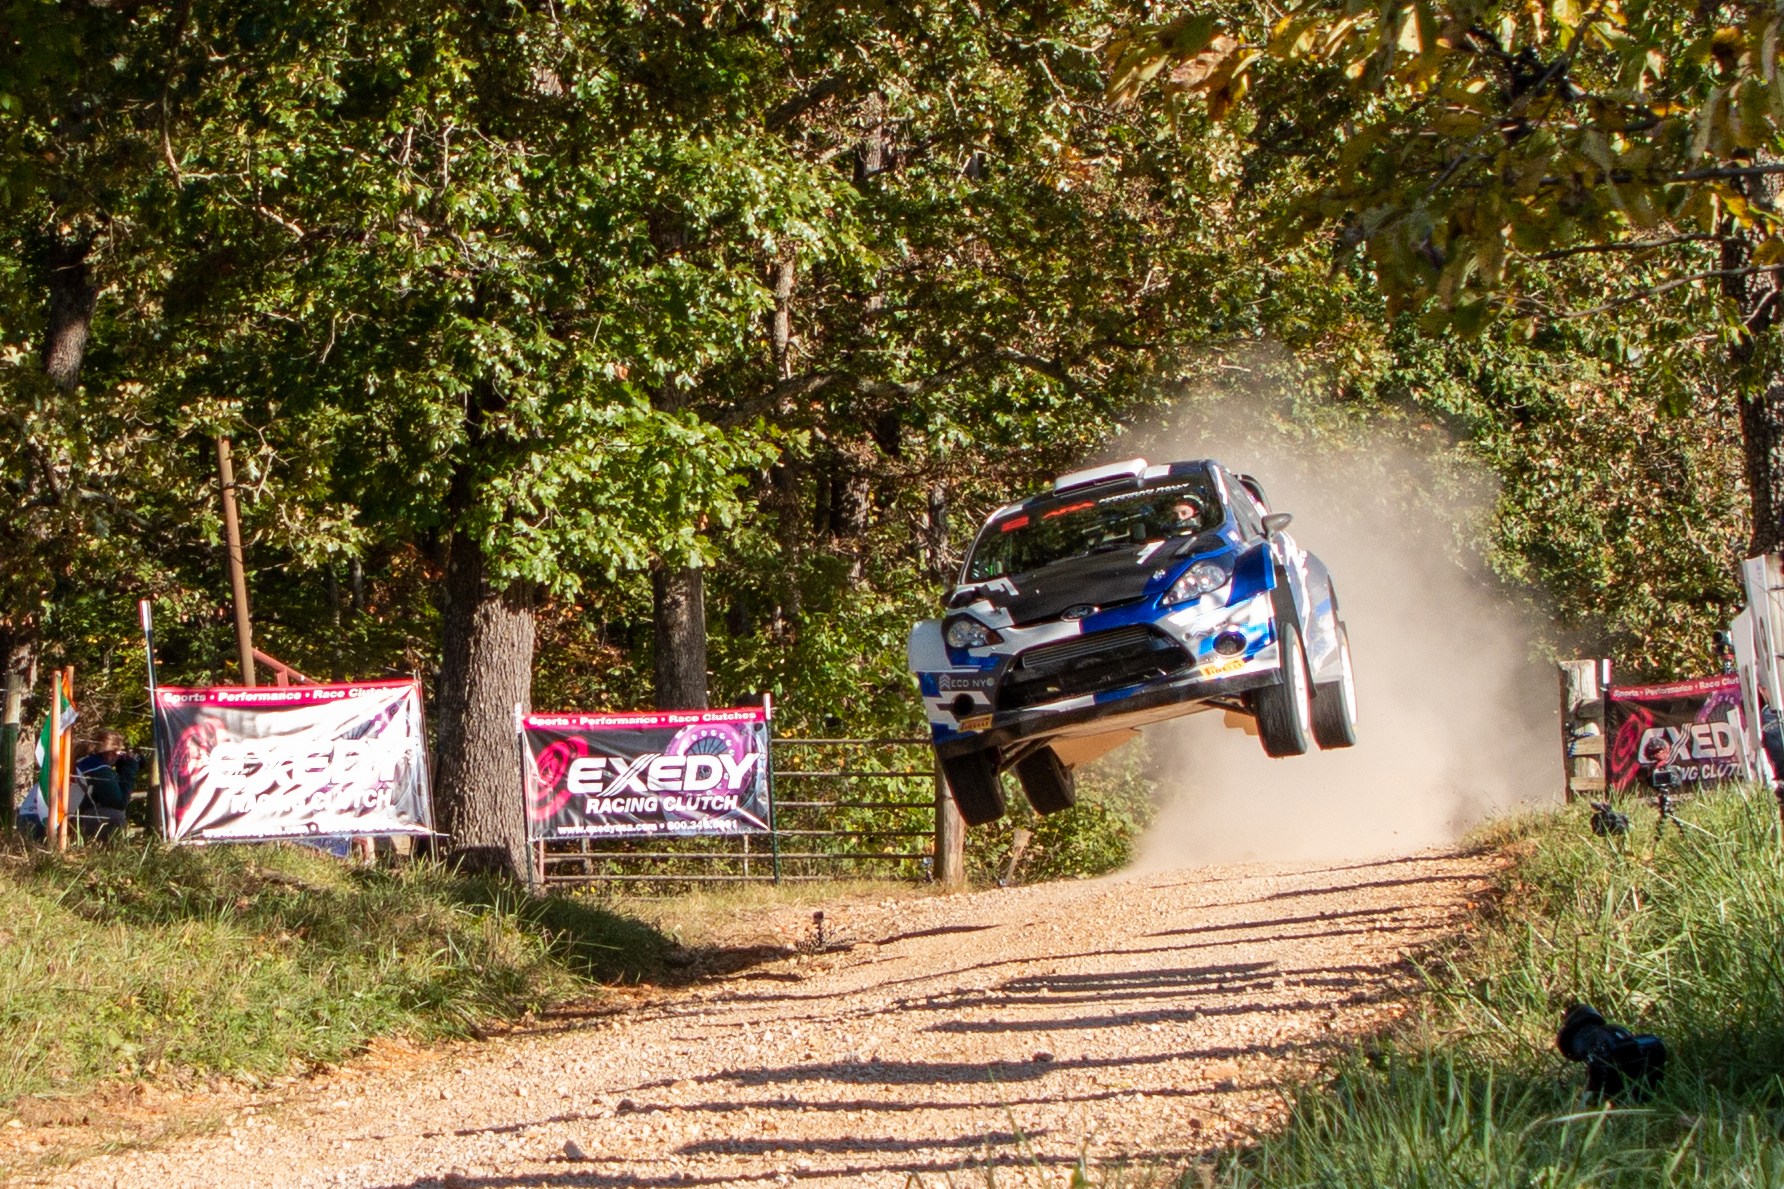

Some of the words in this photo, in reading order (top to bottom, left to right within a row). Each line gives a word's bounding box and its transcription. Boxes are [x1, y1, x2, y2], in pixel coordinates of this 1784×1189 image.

[163, 692, 206, 704] Sports
[217, 690, 302, 702] Performance
[312, 689, 345, 700] Race
[1613, 689, 1639, 698] Sports
[1645, 685, 1694, 696] Performance
[1699, 681, 1720, 690] Race
[1722, 677, 1740, 687] Clut
[528, 716, 569, 726] Sports
[579, 715, 658, 726] Performance
[668, 714, 700, 723] Race
[702, 712, 756, 722] Clutches
[1638, 721, 1740, 765] EXED
[566, 752, 760, 797] EXEDY
[585, 796, 658, 815] RACING
[662, 794, 739, 812] CLUTCH
